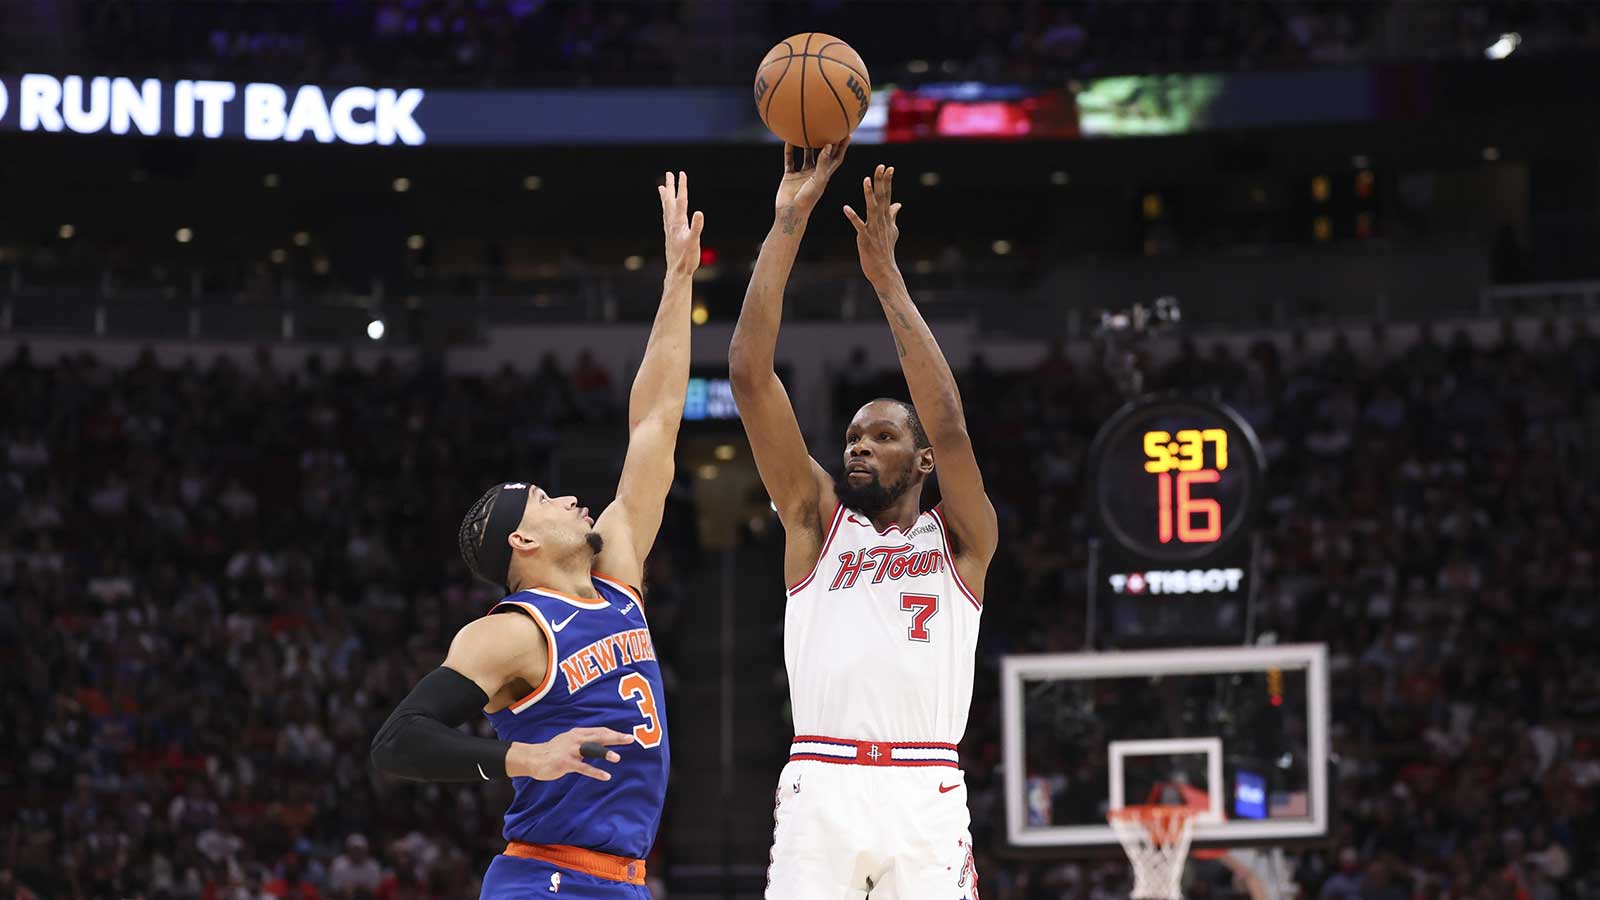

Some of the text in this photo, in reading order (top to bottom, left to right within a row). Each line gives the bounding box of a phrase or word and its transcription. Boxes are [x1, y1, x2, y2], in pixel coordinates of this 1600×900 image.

[20, 73, 161, 136] RUN
[174, 80, 235, 138] IT
[244, 82, 426, 146] BACK
[1143, 428, 1228, 473] 5:37
[1158, 469, 1222, 544] 16
[828, 543, 945, 591] H-Town
[1145, 568, 1244, 594] TISSOT
[900, 592, 939, 643] 7
[559, 634, 618, 695] NEW
[618, 672, 662, 749] 3
